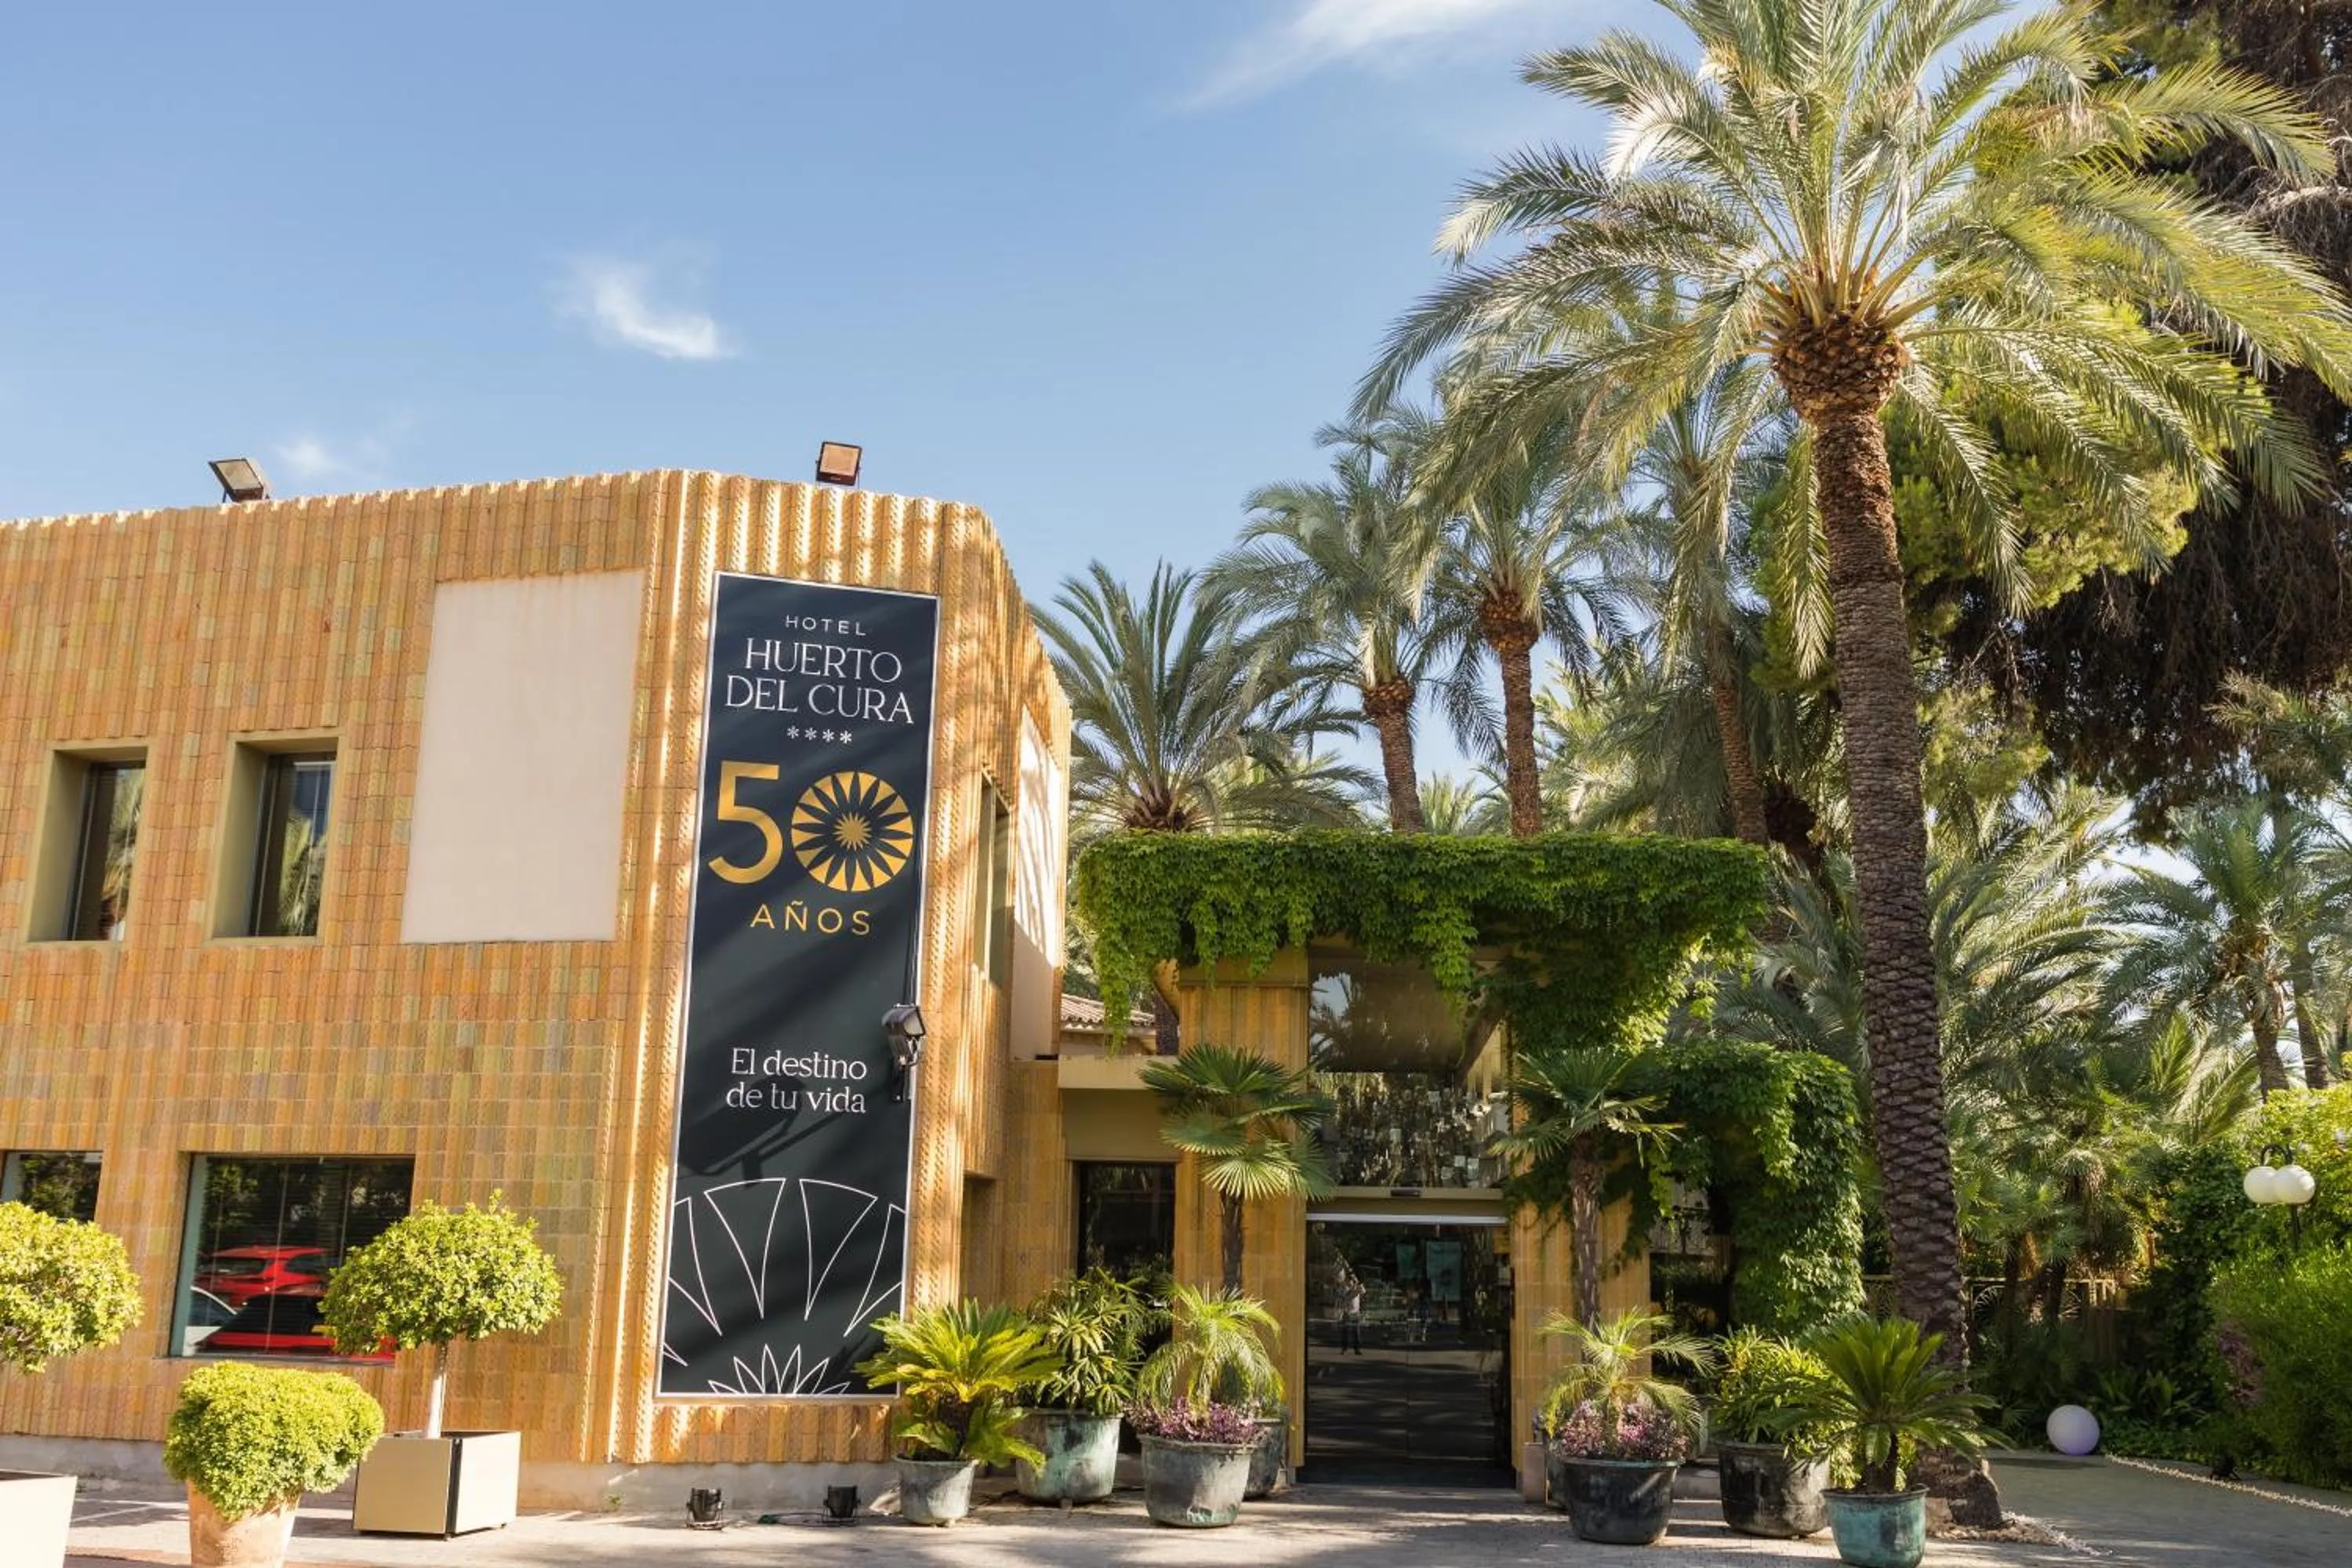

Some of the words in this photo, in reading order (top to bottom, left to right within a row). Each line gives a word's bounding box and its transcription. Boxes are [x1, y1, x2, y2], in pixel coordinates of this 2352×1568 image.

[785, 615, 866, 636] HOTEL
[745, 637, 902, 683] HUERTO
[724, 675, 798, 713] DEL
[808, 684, 914, 724] CURA
[708, 760, 914, 892] 50
[750, 900, 870, 935] AÑOS
[731, 1047, 756, 1075] El
[763, 1050, 867, 1080] destino
[726, 1082, 763, 1108] de
[771, 1083, 797, 1109] tu
[806, 1086, 866, 1113] vida
